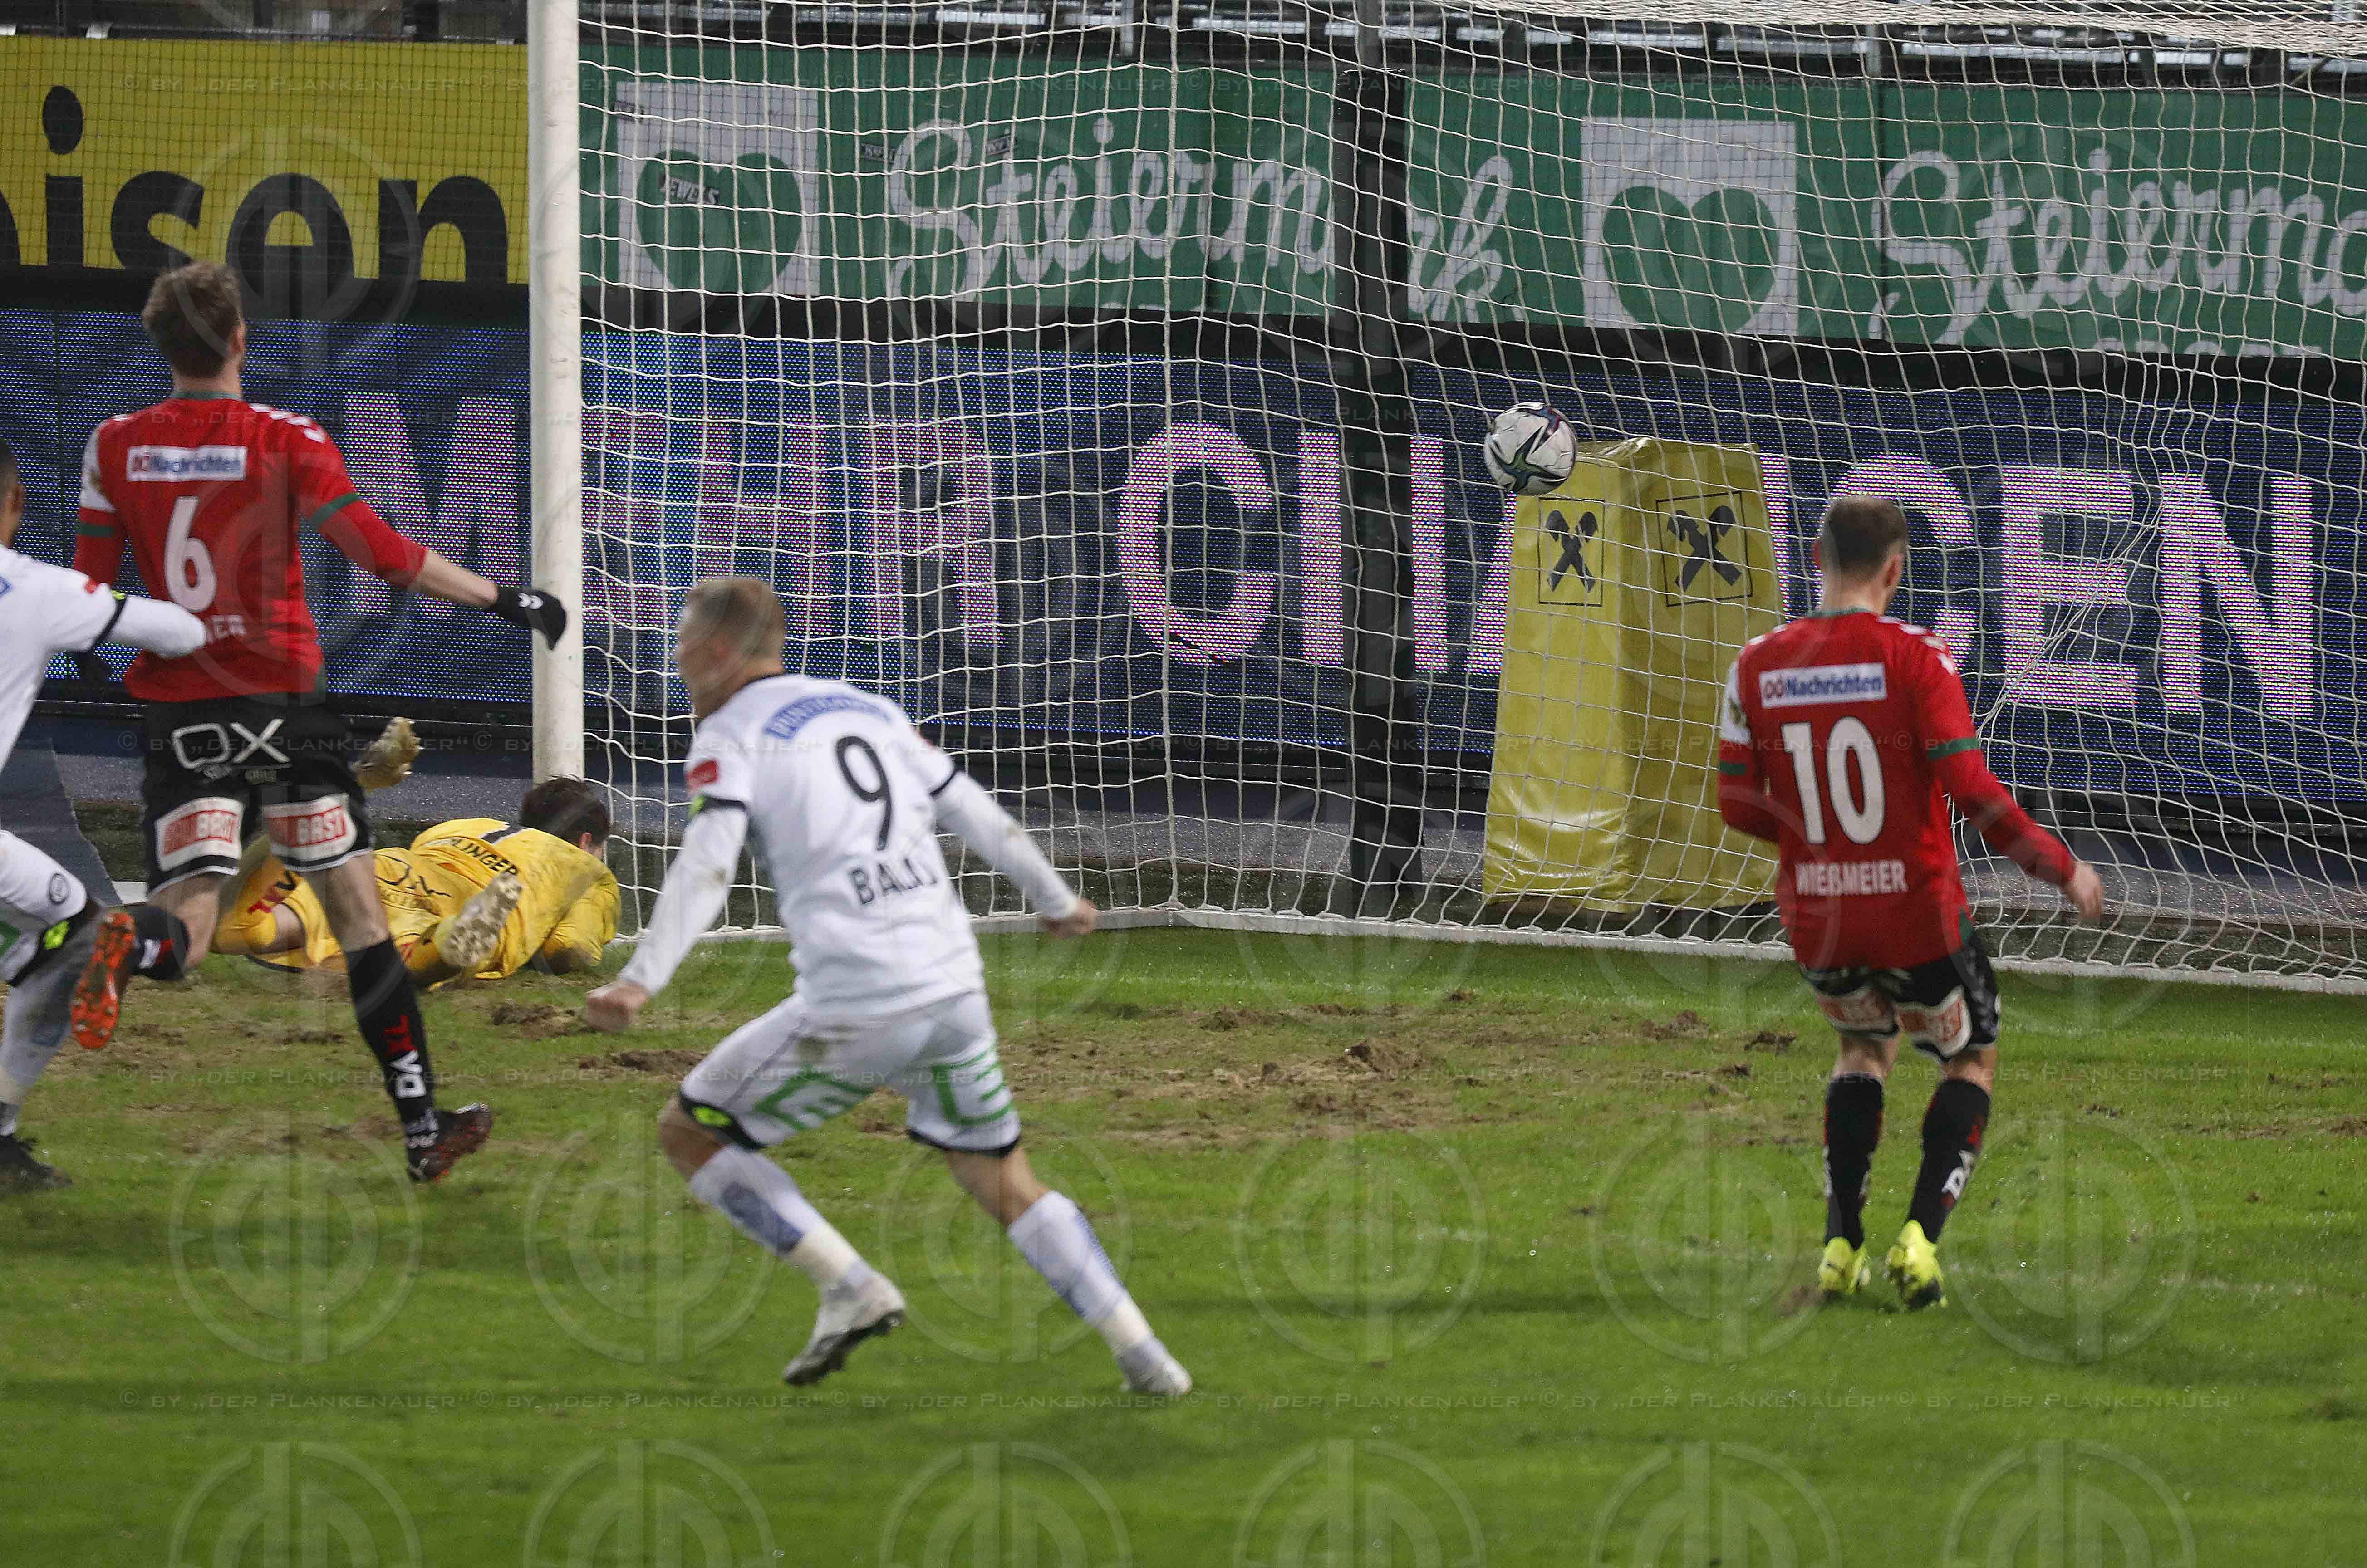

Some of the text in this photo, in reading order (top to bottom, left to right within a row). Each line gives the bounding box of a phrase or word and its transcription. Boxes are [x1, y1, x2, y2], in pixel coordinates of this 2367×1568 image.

[0, 85, 508, 282] isen
[164, 496, 217, 613] 6
[836, 735, 892, 851] 9
[1780, 716, 1886, 845] 10
